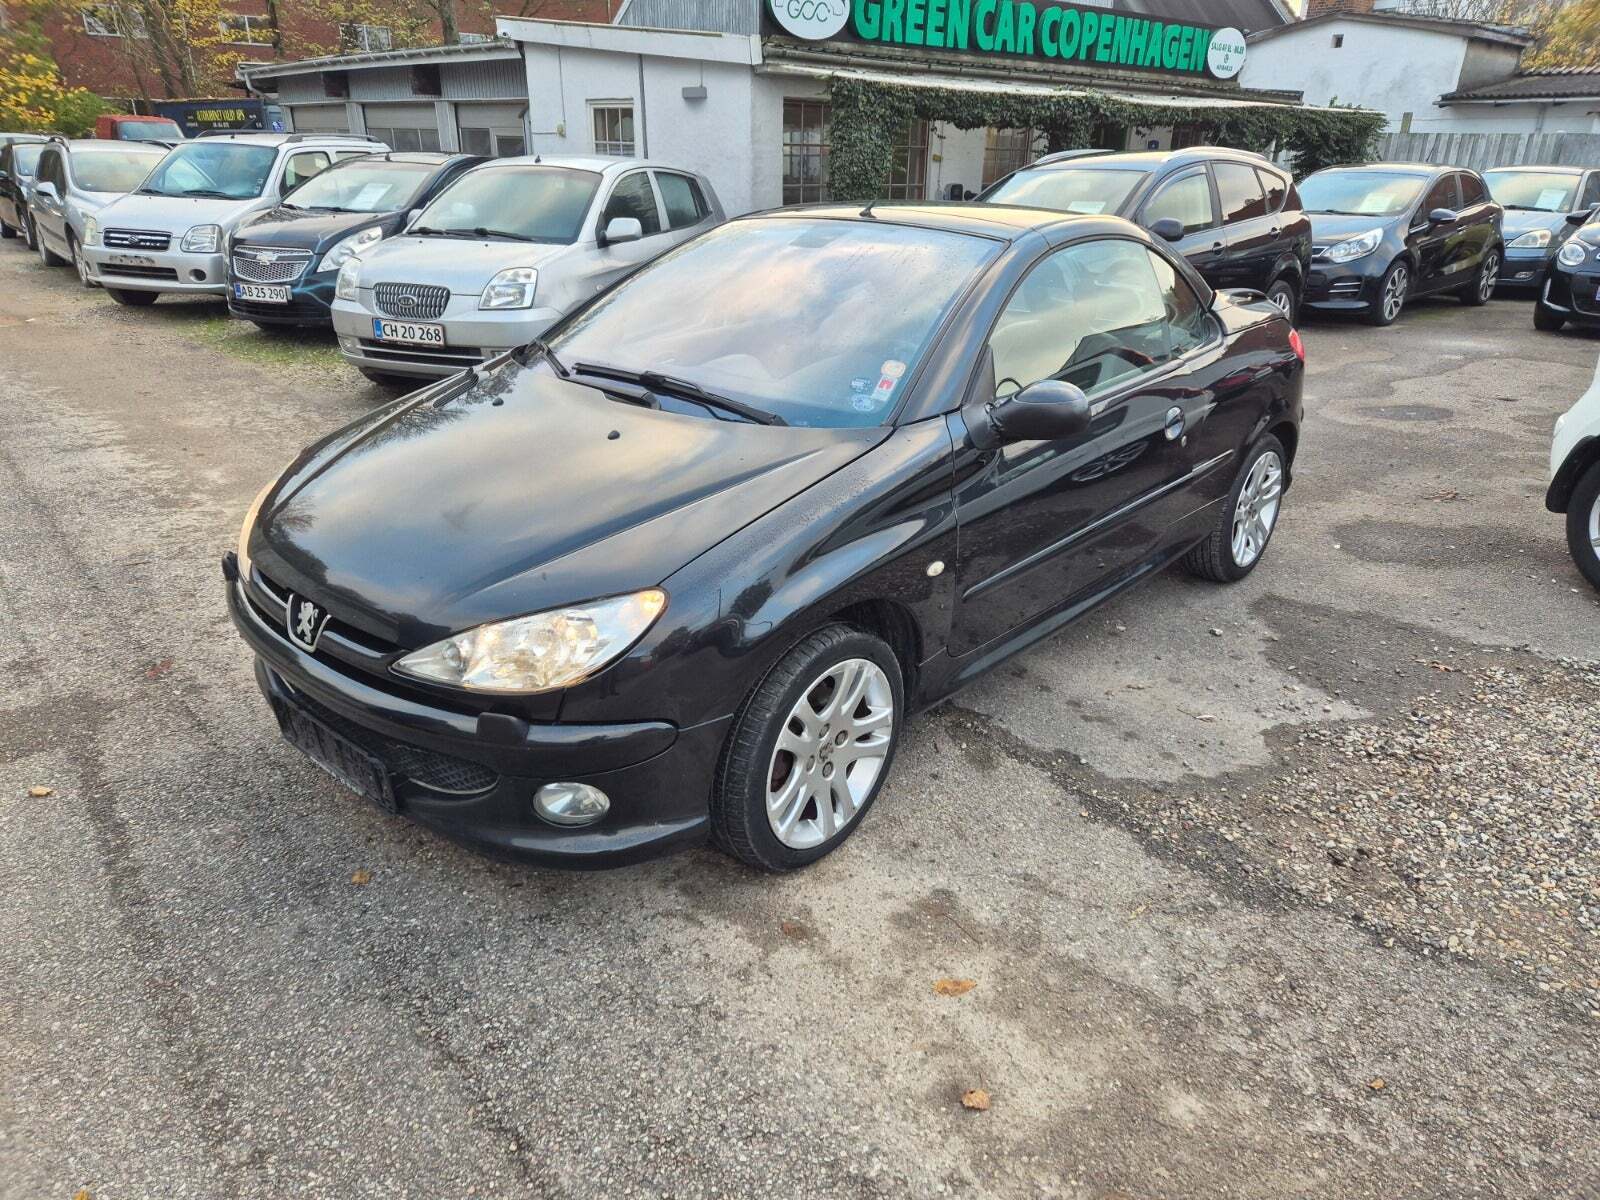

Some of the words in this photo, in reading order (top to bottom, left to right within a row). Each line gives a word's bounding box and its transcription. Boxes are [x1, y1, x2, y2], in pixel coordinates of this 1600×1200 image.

[854, 0, 970, 49] GREEN
[975, 0, 1035, 54] CAR
[1041, 6, 1210, 71] COPENHAGEN
[241, 286, 254, 298] AB
[254, 287, 266, 299] 25
[268, 288, 285, 300] 290
[382, 323, 399, 338] CH
[401, 325, 416, 340] 20
[418, 327, 442, 342] 268
